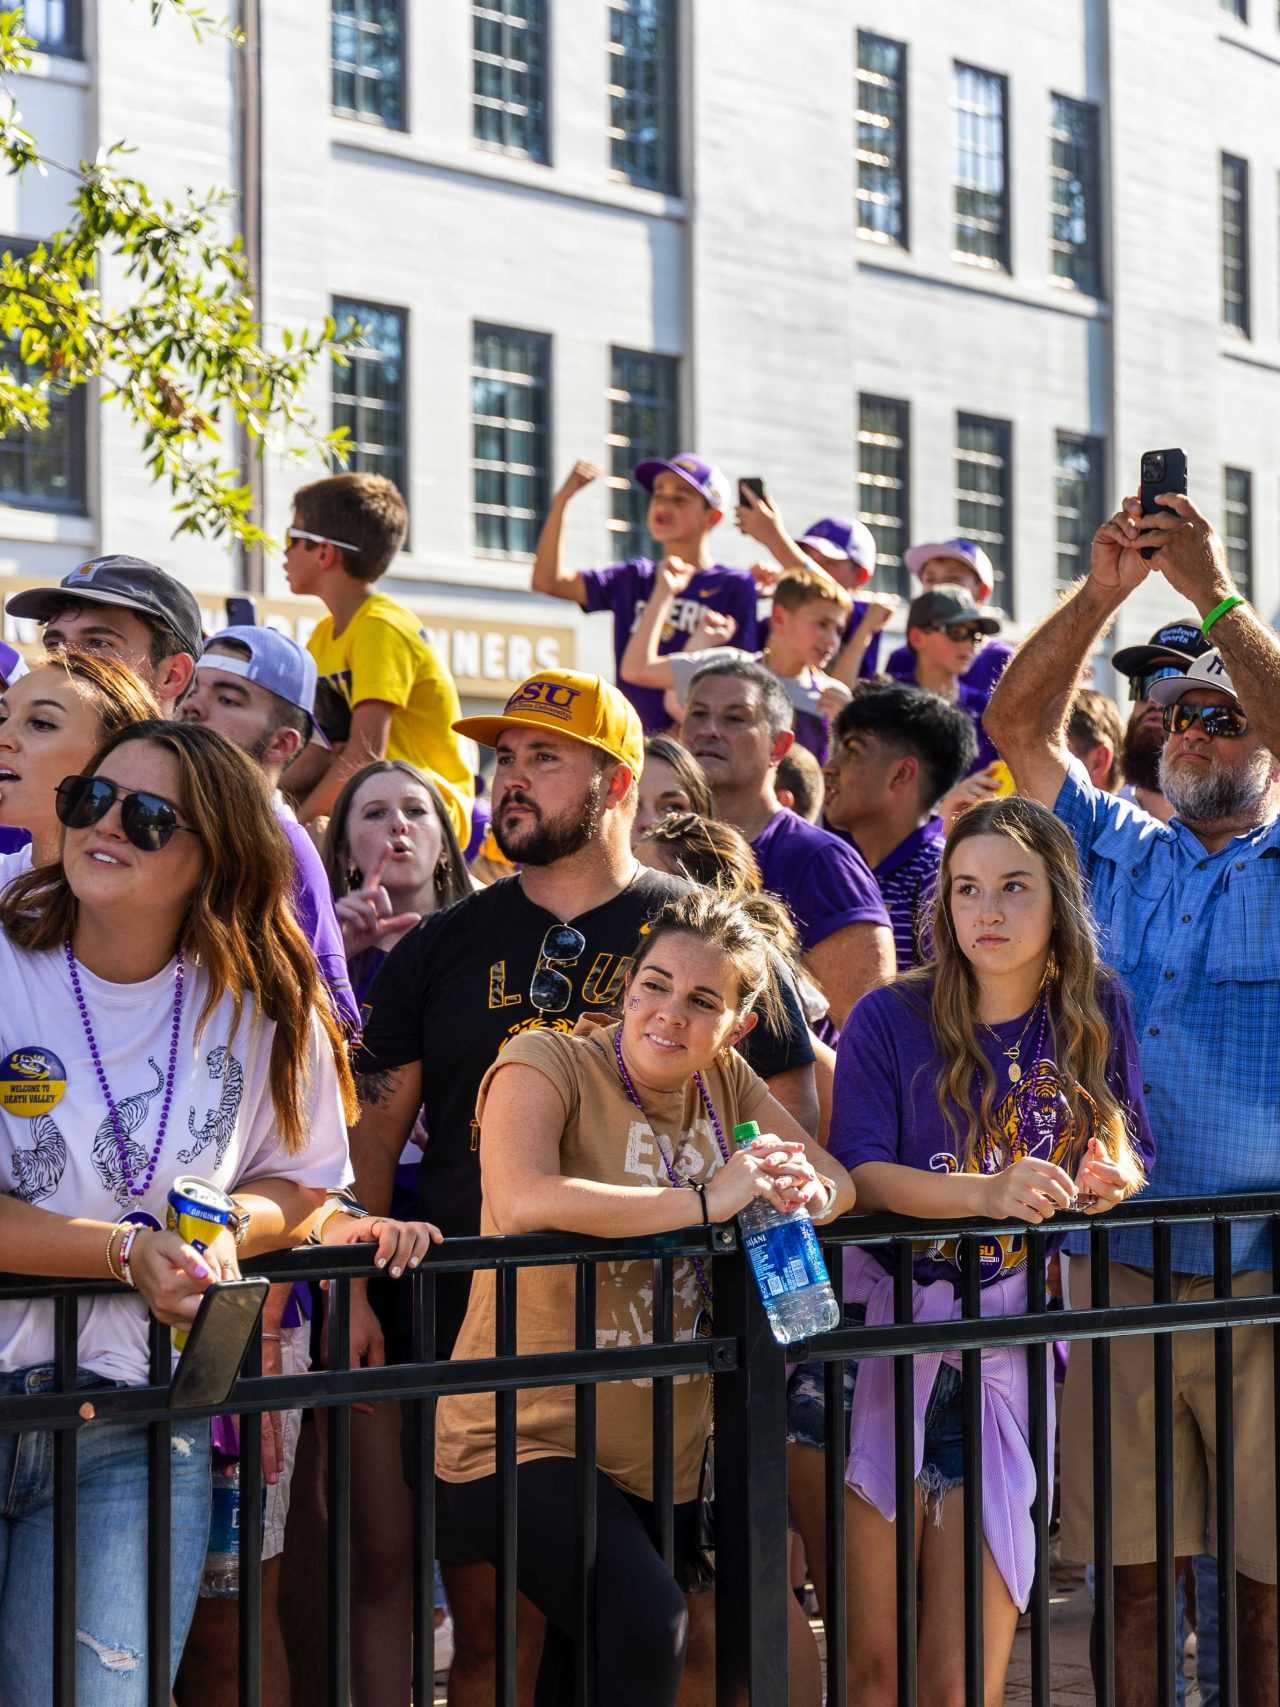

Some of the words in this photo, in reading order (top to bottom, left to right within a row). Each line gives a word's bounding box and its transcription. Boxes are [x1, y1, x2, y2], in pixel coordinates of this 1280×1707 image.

[488, 953, 636, 1009] LU
[4, 1094, 27, 1105] DEATH
[29, 1094, 56, 1105] VALLEY
[191, 1207, 221, 1223] ORIGINAL
[979, 1244, 996, 1256] SU
